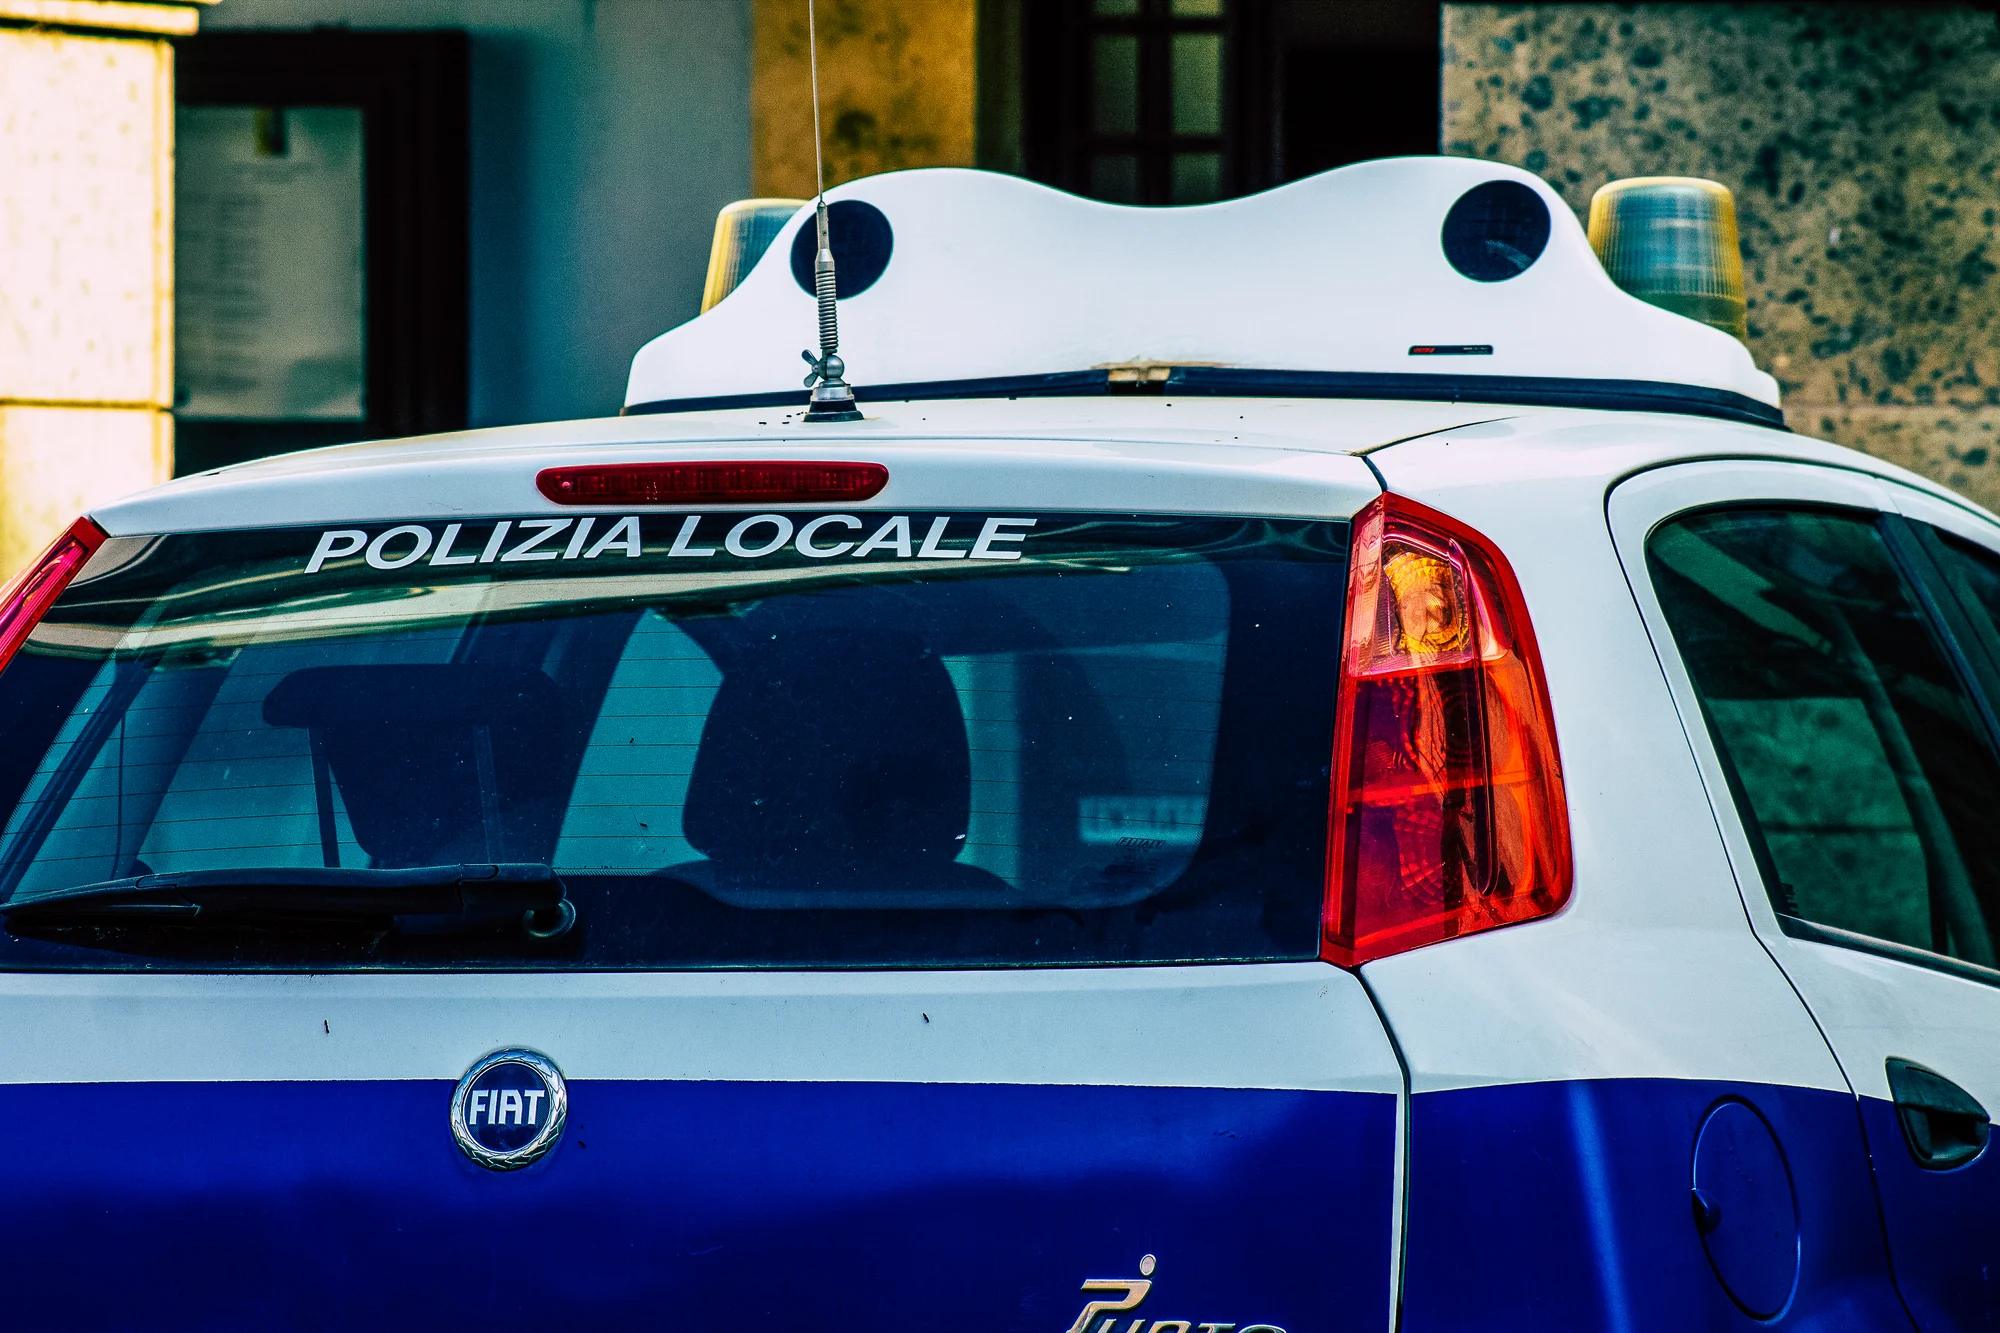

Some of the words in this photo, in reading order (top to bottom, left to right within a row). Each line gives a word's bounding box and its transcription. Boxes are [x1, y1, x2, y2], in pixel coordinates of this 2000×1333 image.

[304, 516, 641, 573] POLIZIA
[667, 514, 1037, 559] LOCALE
[469, 1089, 545, 1125] FIAT
